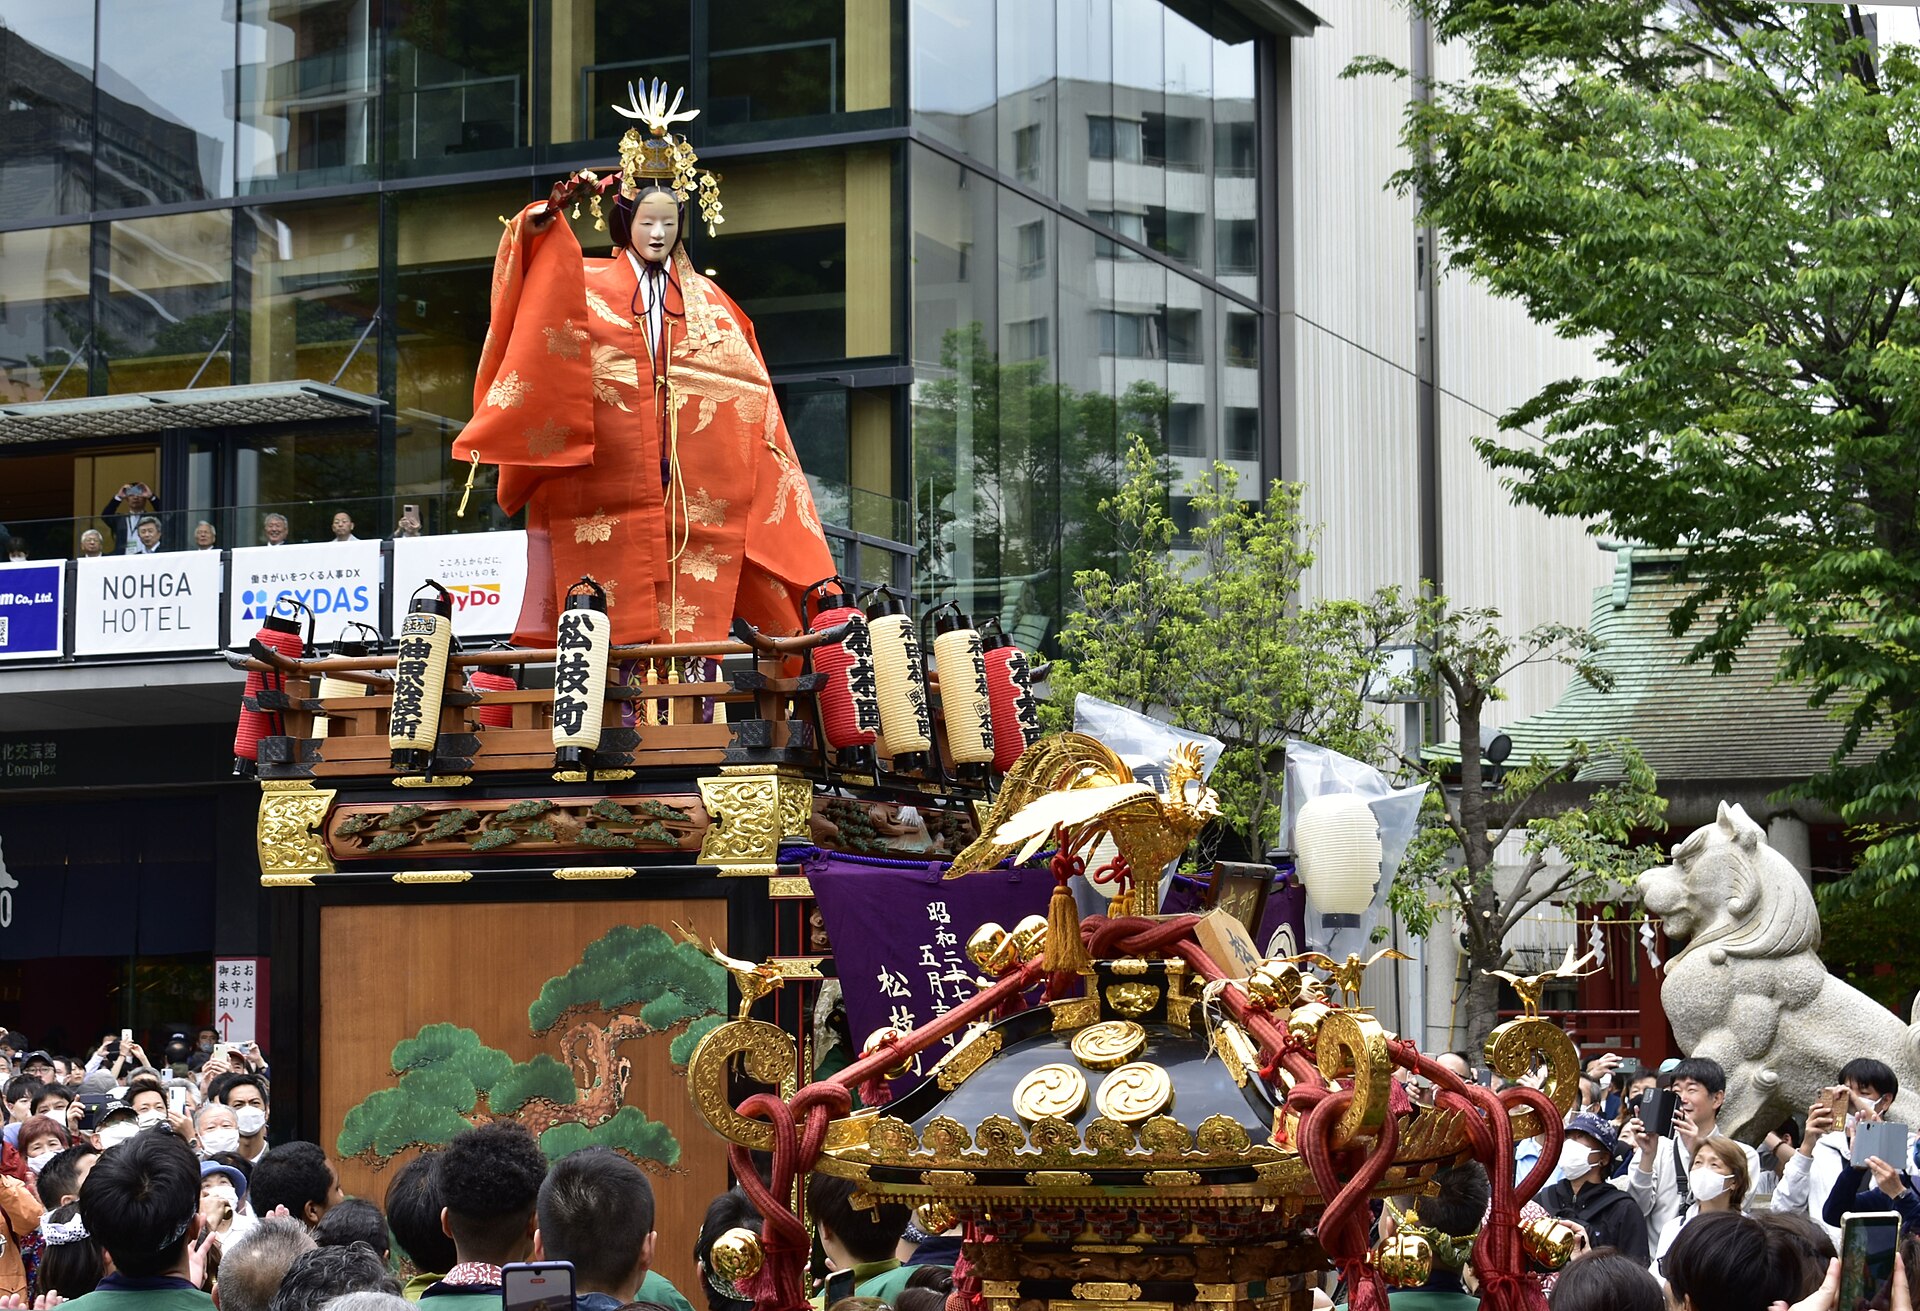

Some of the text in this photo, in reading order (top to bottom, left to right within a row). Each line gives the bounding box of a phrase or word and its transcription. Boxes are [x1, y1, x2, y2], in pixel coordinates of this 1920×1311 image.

[103, 572, 192, 600] NOHGA
[251, 569, 361, 584] 働きがいをつくる人事DX
[34, 592, 53, 603] Ltd.
[276, 585, 369, 615] CYDAS
[102, 606, 191, 633] HOTEL
[391, 637, 432, 740] 神田松枝町
[554, 614, 595, 736] 松枝町
[7, 761, 57, 778] Complex
[218, 965, 229, 1008] 御朱印
[231, 965, 241, 1008] お守り
[243, 965, 254, 1008] おふだ
